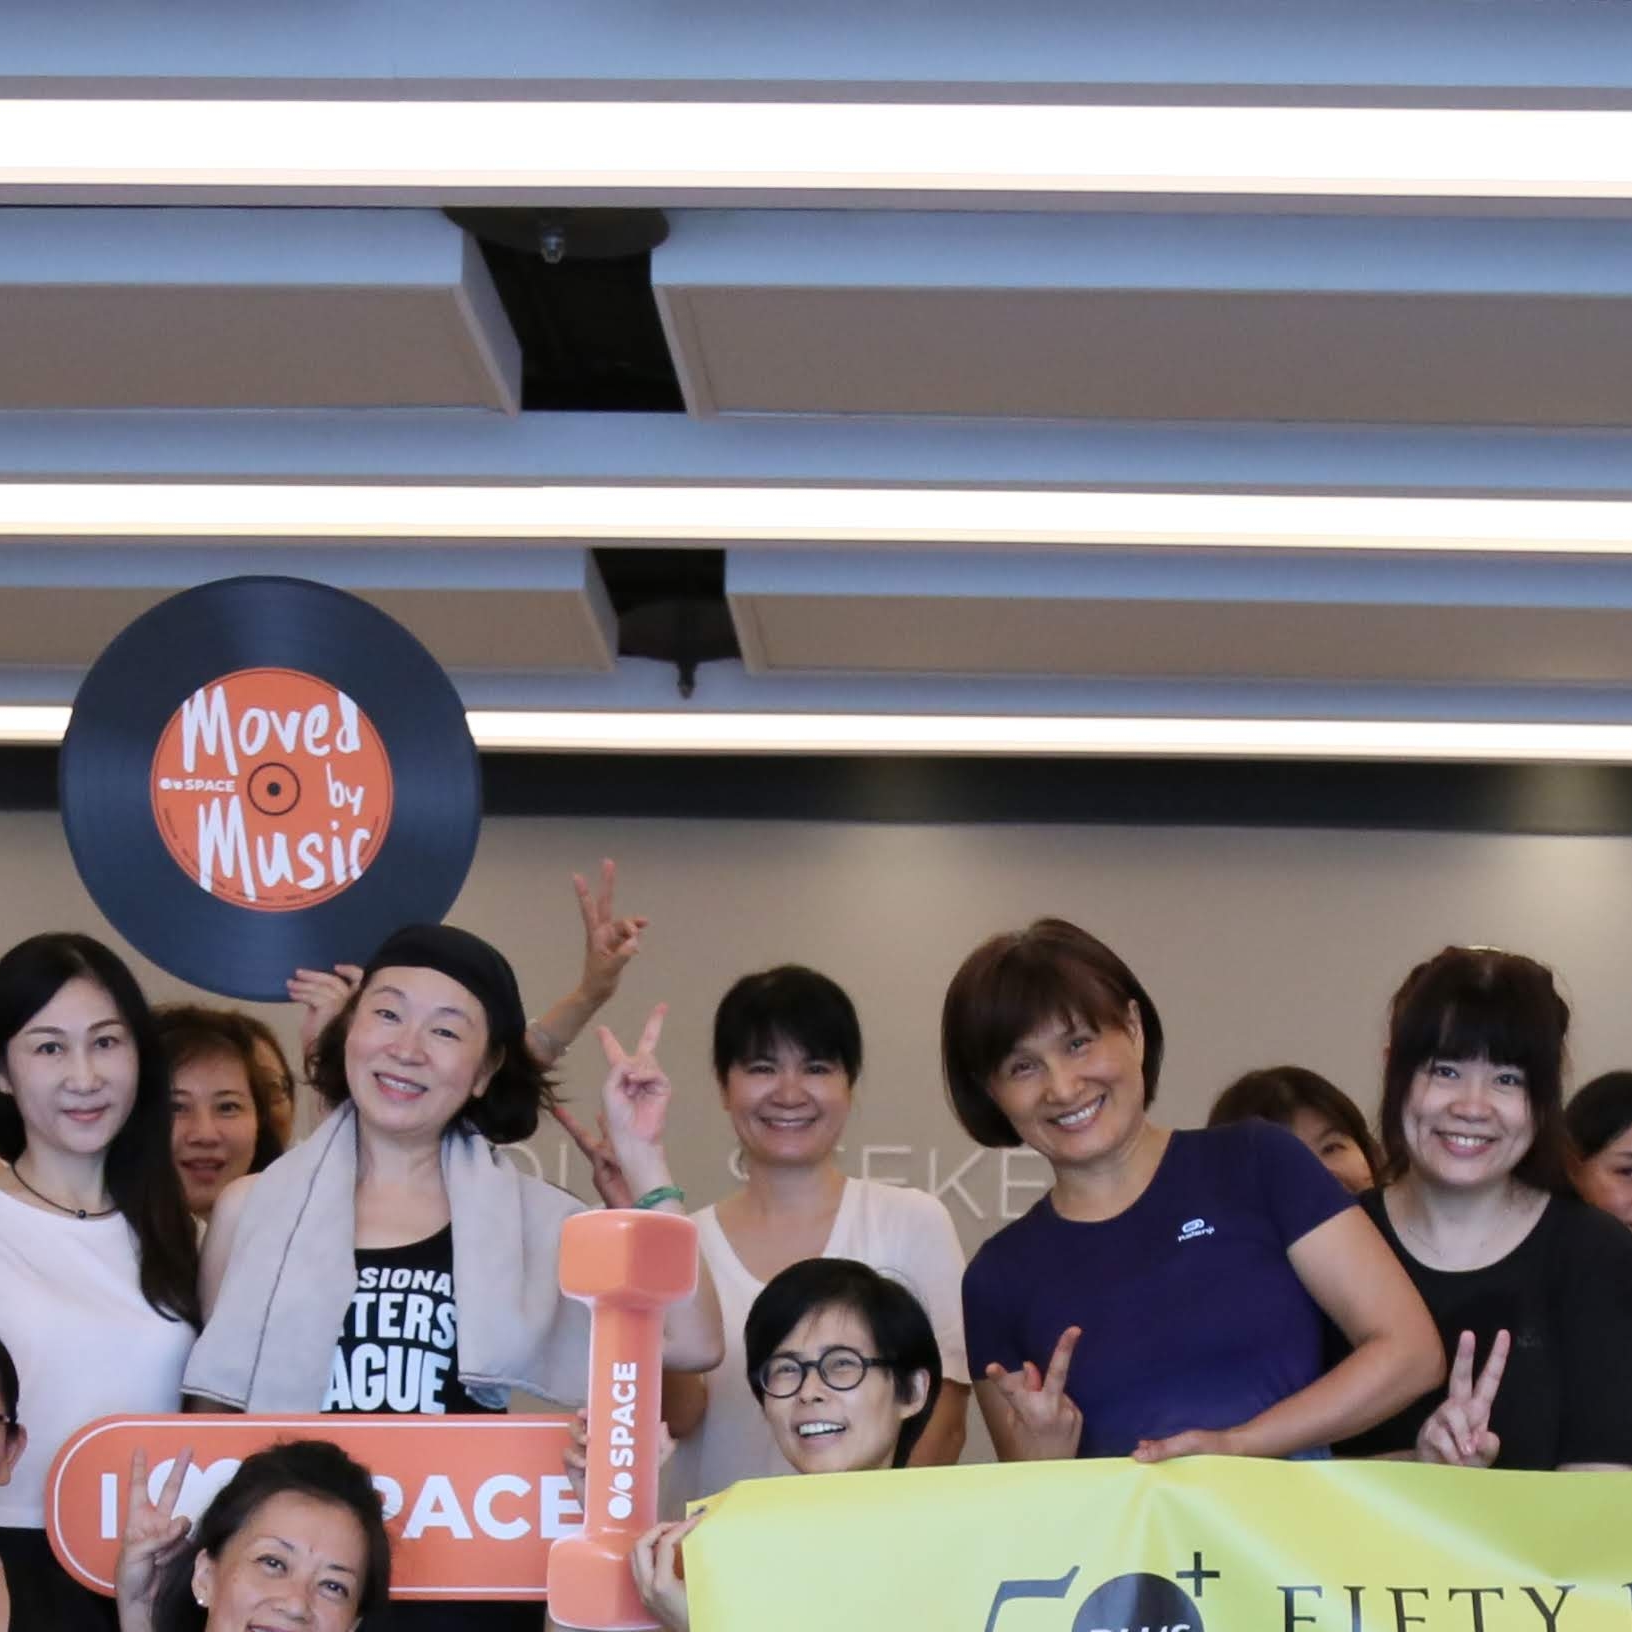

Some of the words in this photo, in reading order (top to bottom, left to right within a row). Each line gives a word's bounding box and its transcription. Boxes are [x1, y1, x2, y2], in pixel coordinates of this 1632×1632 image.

[181, 685, 360, 775] Moved
[184, 778, 236, 793] SPACE
[325, 762, 364, 817] by
[197, 794, 371, 902] Music
[609, 1362, 637, 1468] SPACE
